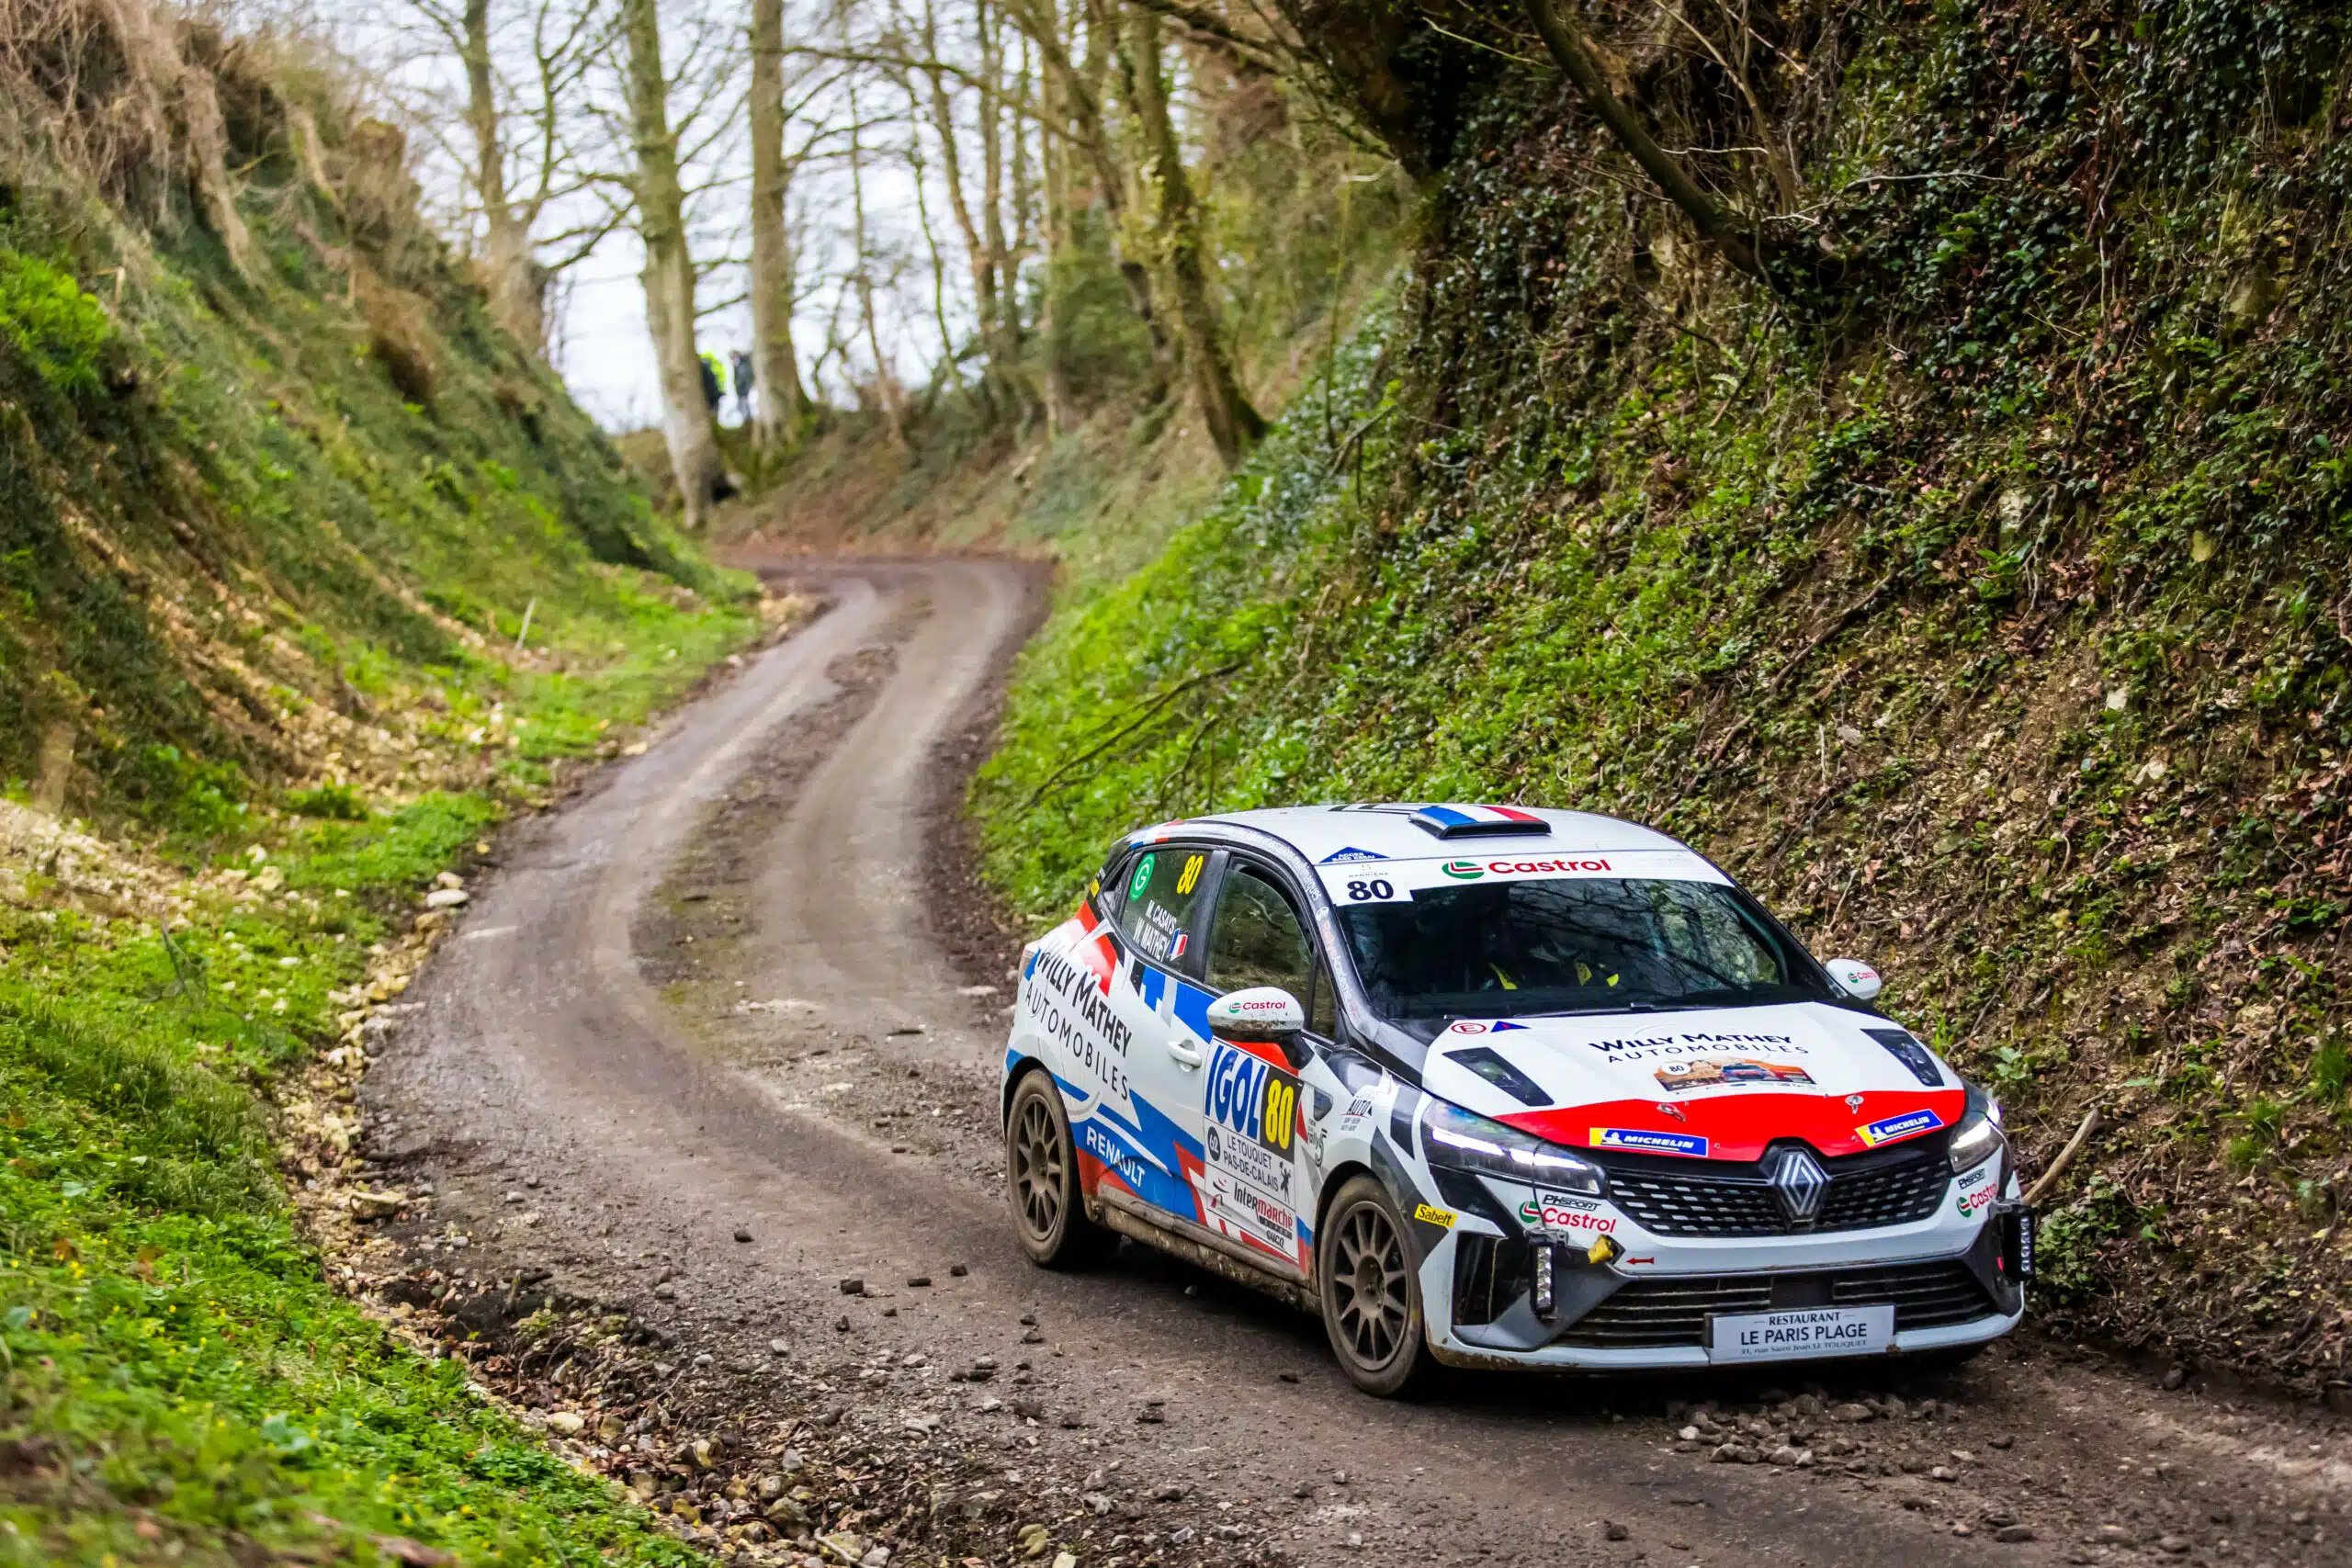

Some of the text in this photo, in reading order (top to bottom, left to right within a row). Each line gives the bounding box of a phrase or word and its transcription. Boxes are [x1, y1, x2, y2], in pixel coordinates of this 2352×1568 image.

[1135, 863, 1150, 892] G
[1177, 855, 1204, 895] 80
[1488, 859, 1613, 874] Castrol
[1347, 879, 1395, 901] 80
[1152, 905, 1177, 935] CASAYS
[1140, 923, 1170, 964] MATHEY
[1037, 952, 1133, 1059] WILLY MATHEY
[1242, 1001, 1286, 1010] Castrol
[1024, 981, 1129, 1101] AUTOMOBILES
[1589, 1033, 1792, 1053] WILLY MATHEY
[1608, 1043, 1810, 1064] AUTOMOBILES
[1204, 1044, 1295, 1150] IGOL 80
[1884, 1116, 1930, 1134] MICHELIN
[1227, 1134, 1272, 1170] LE TOUQUET
[1623, 1134, 1695, 1149] MICHELIN
[1086, 1125, 1146, 1188] RENAULT
[1223, 1150, 1279, 1192] PAS-DE-CALAIS
[1418, 1205, 1453, 1226] Sabelt
[1543, 1207, 1617, 1233] Castrol
[1769, 1312, 1840, 1325] RESTAURANT
[1741, 1323, 1868, 1346] LE PARIS PLAGE
